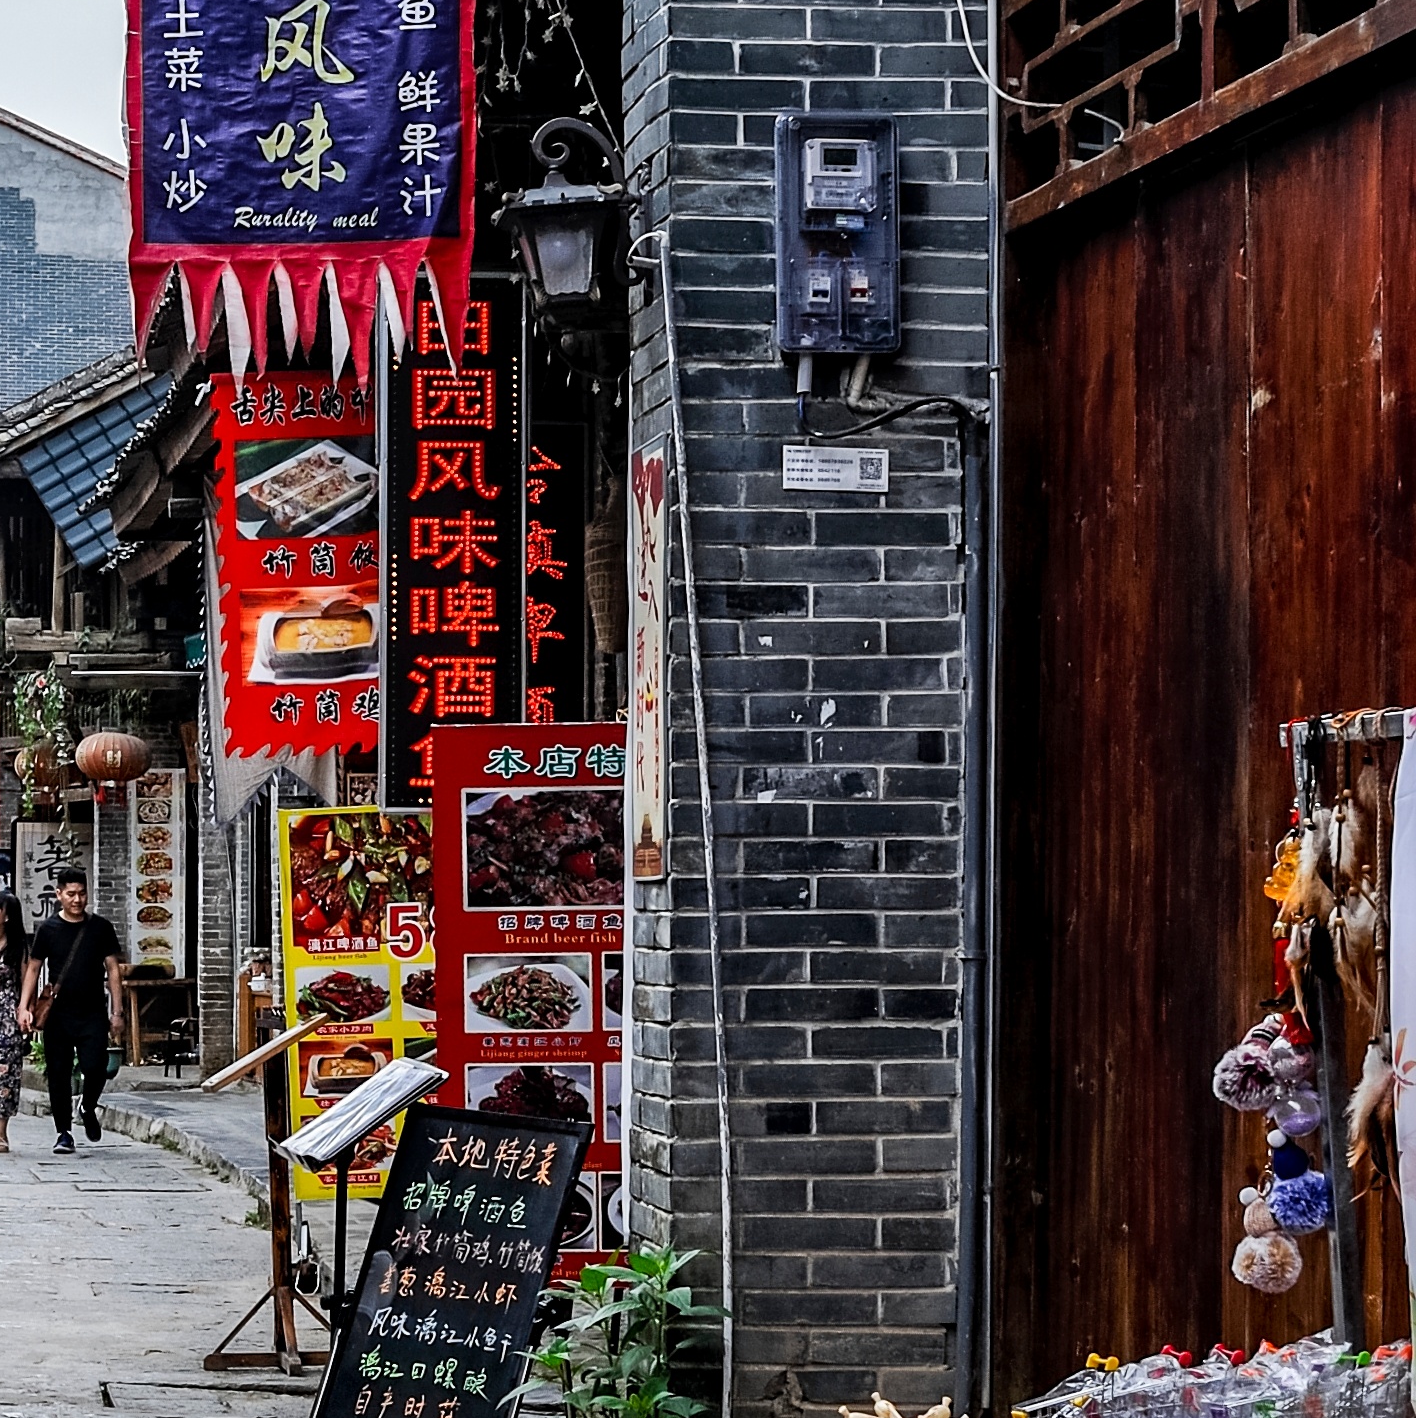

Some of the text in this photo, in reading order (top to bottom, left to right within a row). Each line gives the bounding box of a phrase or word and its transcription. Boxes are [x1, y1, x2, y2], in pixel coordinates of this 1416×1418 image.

[396, 69, 442, 219] 鲜果汁
[161, 118, 207, 214] 小炒
[233, 205, 379, 233] Rurality meal
[260, 540, 381, 580] 竹筒饭
[406, 299, 502, 789] 田园风味啤酒
[270, 686, 381, 727] 竹筒鸡
[387, 902, 436, 961] 5
[498, 913, 624, 930] 招牌啤酒鱼
[505, 931, 617, 944] Brand beer fish
[307, 936, 379, 952] 漓江啤酒鱼
[480, 1049, 516, 1059] Lijiang
[431, 1127, 559, 1187] 本地特色菜
[402, 1180, 528, 1229] 招牌啤酒鱼
